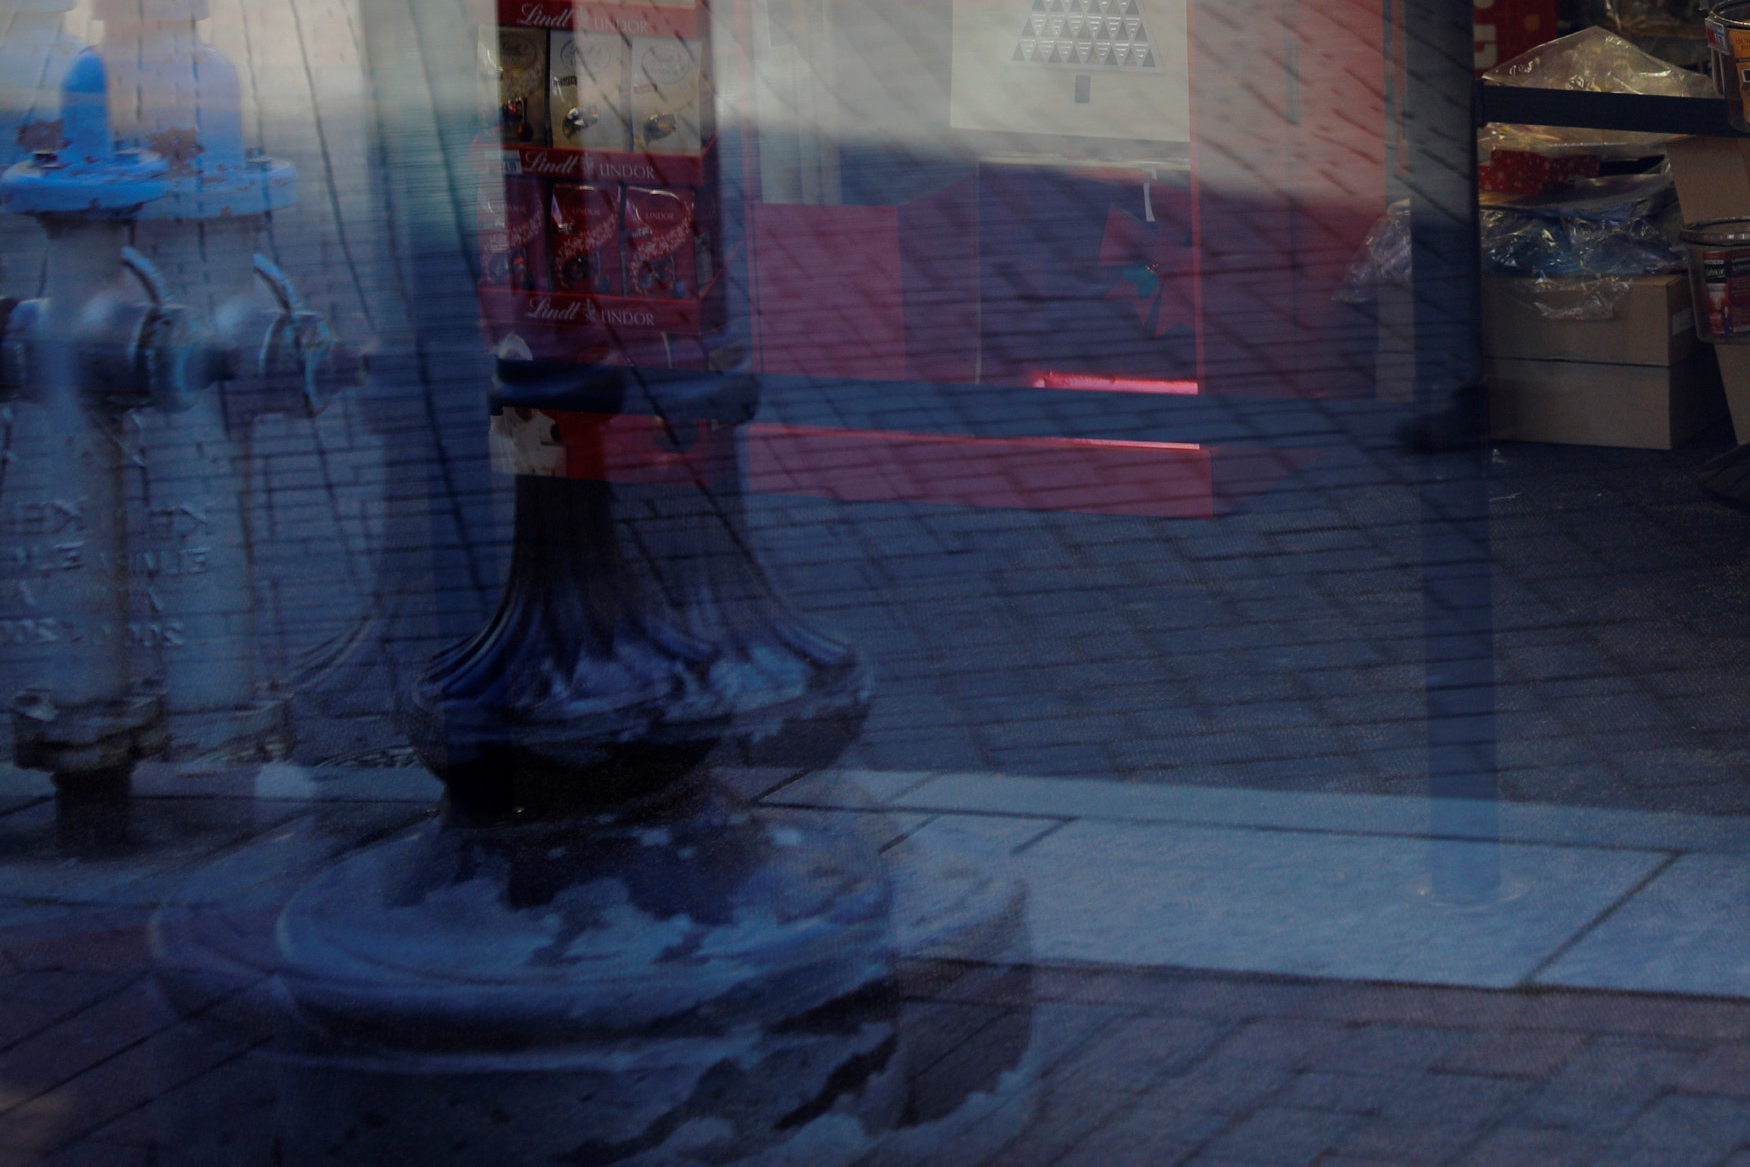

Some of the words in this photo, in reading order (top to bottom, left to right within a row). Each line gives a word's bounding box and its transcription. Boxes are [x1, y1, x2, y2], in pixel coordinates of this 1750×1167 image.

[523, 150, 579, 174] Lindt
[600, 163, 656, 180] LINDOR
[526, 296, 582, 321] Lindt
[601, 308, 656, 327] LINDOR
